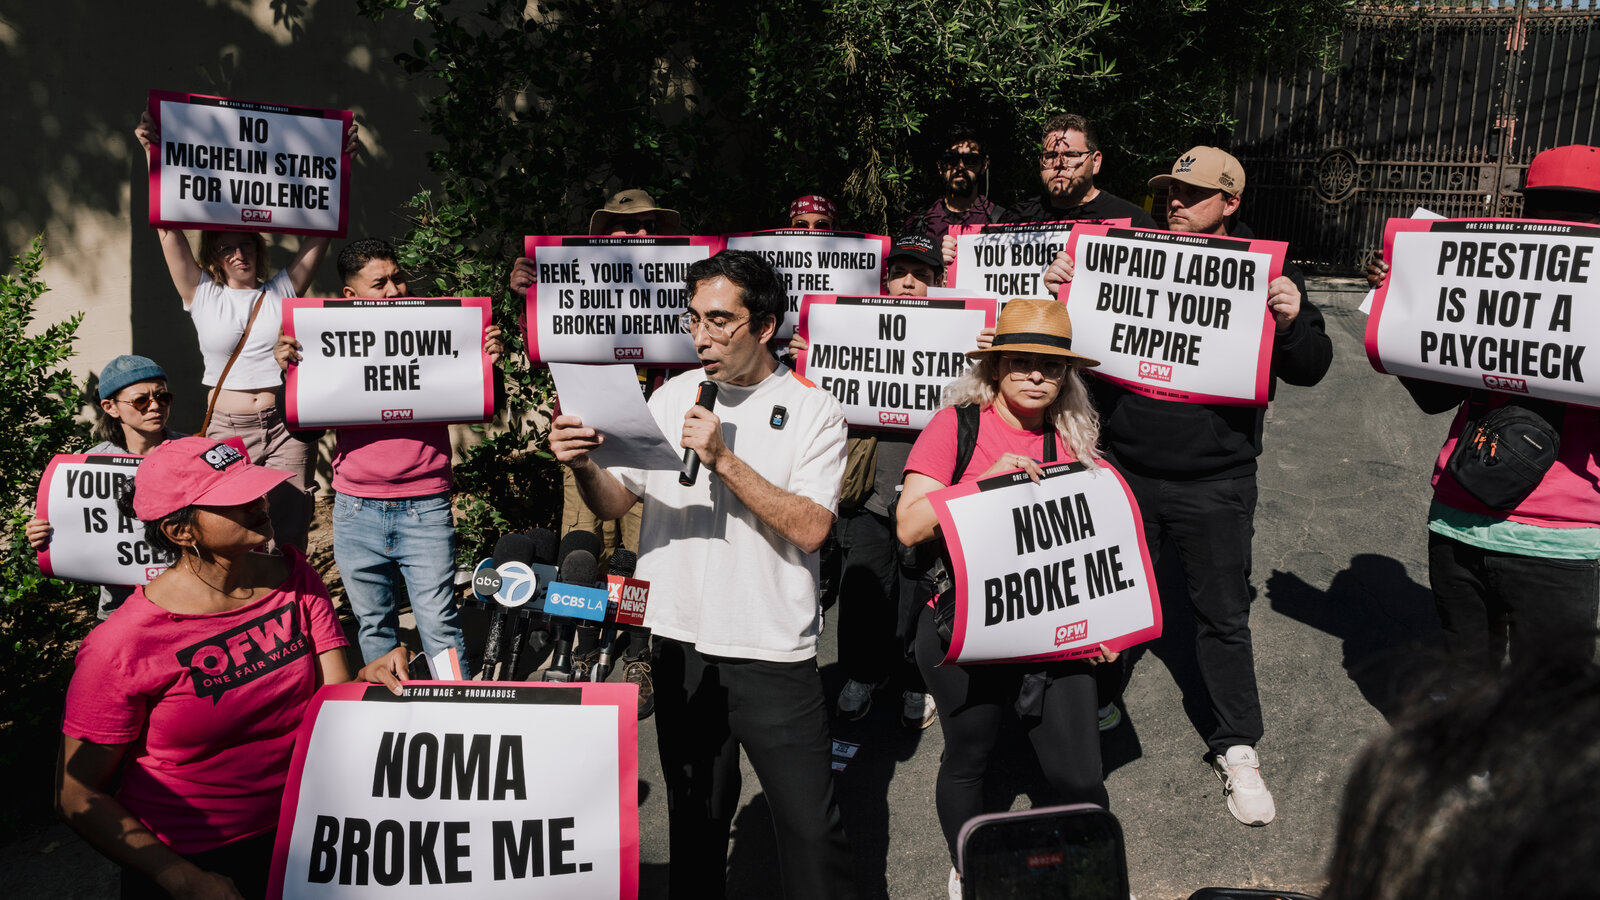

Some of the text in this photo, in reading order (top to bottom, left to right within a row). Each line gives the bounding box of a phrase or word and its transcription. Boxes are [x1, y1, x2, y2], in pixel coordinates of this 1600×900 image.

[240, 116, 268, 143] NO
[166, 142, 336, 179] MICHELIN STARS
[180, 175, 329, 210] FOR VIOLENCE
[243, 210, 270, 218] OFW
[818, 252, 876, 270] WORKED
[974, 244, 1006, 267] YOU
[1085, 242, 1256, 291] UNPAID LABOR
[1437, 241, 1594, 283] PRESTIGE
[540, 258, 690, 285] RENÉ, YOUR ‘GENIU
[798, 274, 834, 291] FREE.
[984, 273, 1040, 296] TICKET
[559, 289, 688, 309] IS BUILT ON OUR
[1096, 282, 1232, 330] BUILT YOUR
[1436, 287, 1572, 332] IS NOT A
[553, 315, 615, 335] BROKEN
[879, 314, 906, 341] NO
[321, 330, 458, 358] STEP DOWN,
[1110, 323, 1202, 366] EMPIRE
[1421, 330, 1586, 383] PAYCHECK
[811, 344, 904, 375] MICHELIN
[1141, 363, 1170, 376] OFW
[364, 358, 420, 391] RENÉ
[1485, 376, 1523, 389] OFW
[822, 376, 941, 411] FOR VIOLEN
[880, 413, 907, 421] OFW
[67, 470, 126, 500] YOUR
[83, 508, 134, 533] IS A
[1012, 492, 1096, 555] NOMA
[476, 577, 500, 588] abc
[500, 567, 531, 604] 7
[623, 585, 648, 602] KNX
[984, 545, 1135, 626] BROKE ME.
[562, 595, 585, 608] CBS
[588, 598, 603, 611] LA
[621, 600, 645, 612] NEWS
[191, 609, 292, 676] OFW
[1057, 622, 1086, 640] OFW
[203, 639, 305, 688] ONE FAIR WAGE
[403, 688, 411, 697] NE
[433, 688, 454, 697] WAGE
[465, 689, 516, 698] #NOMAABUSE
[372, 731, 527, 801] NOMA
[308, 815, 592, 886] BROKE ME.
